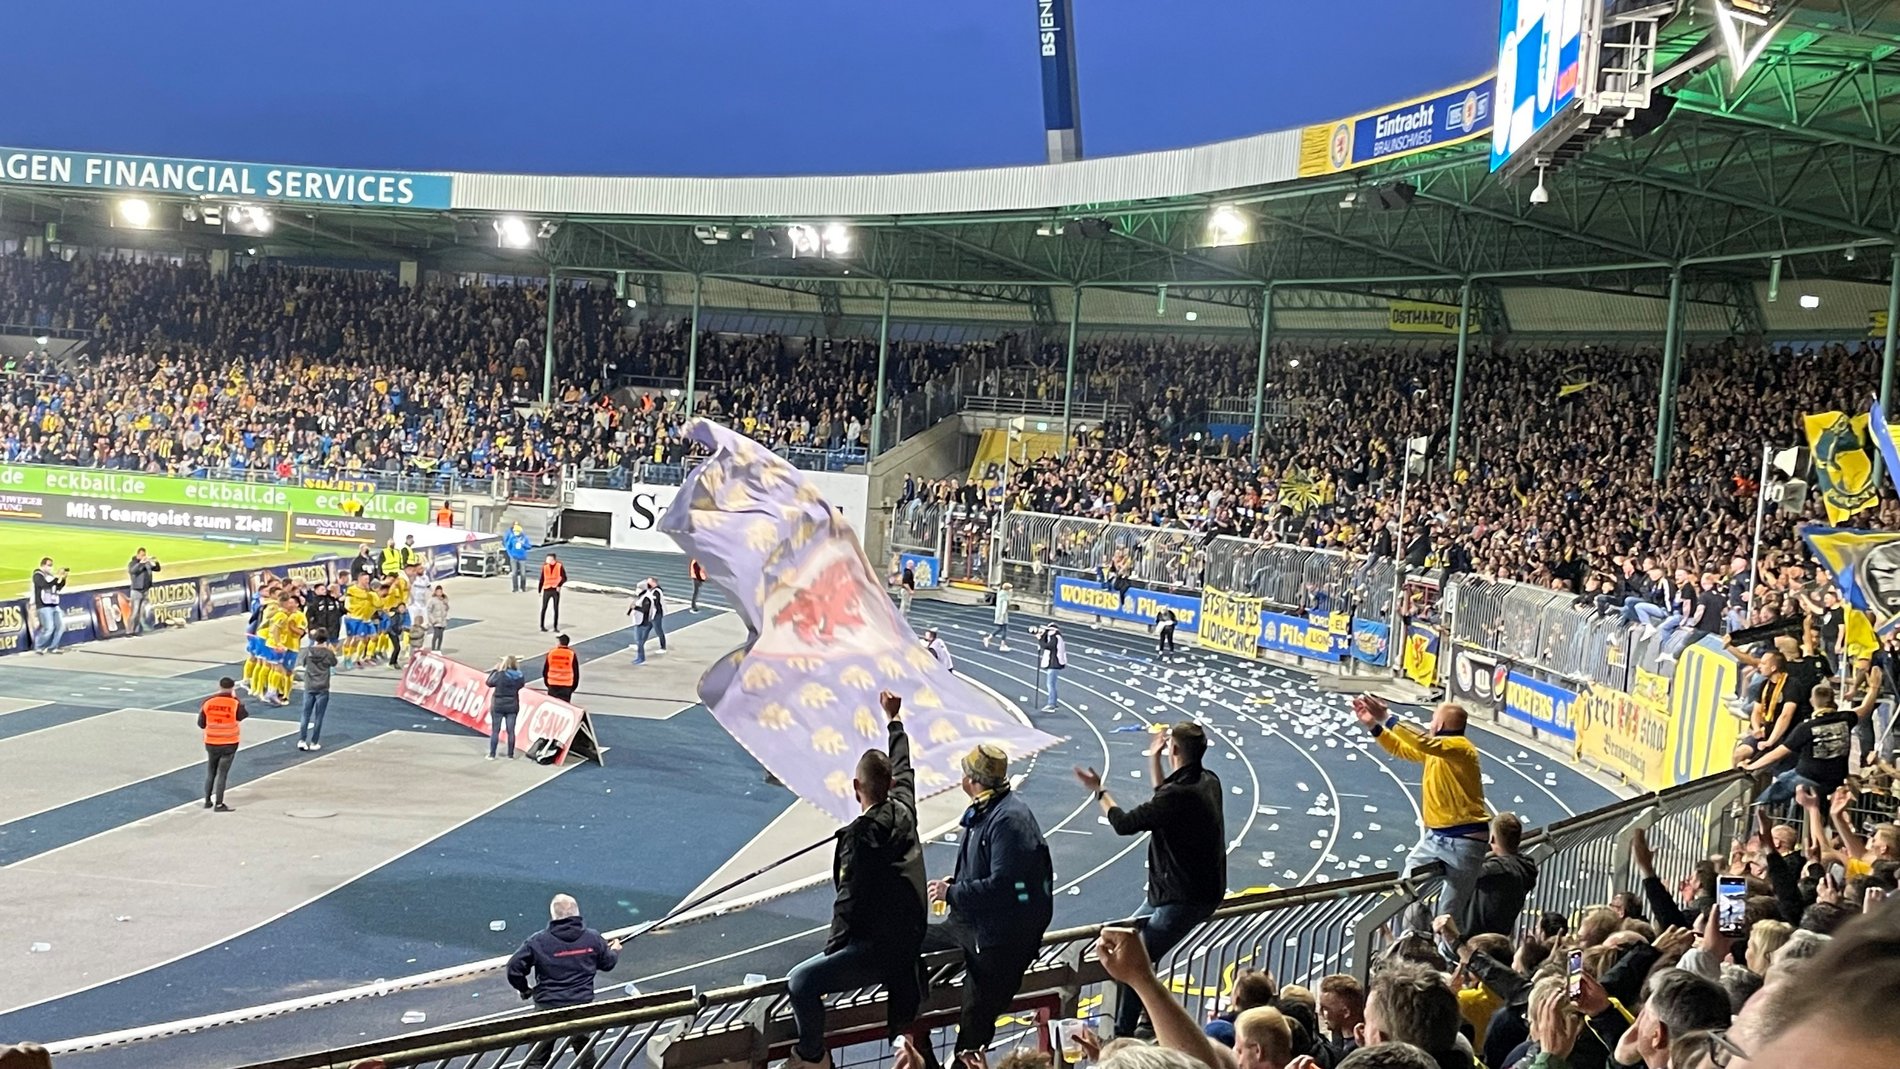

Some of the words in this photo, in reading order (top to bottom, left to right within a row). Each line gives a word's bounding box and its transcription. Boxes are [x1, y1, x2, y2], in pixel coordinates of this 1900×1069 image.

[1039, 0, 1061, 57] BS|EN
[1375, 104, 1435, 138] Eintracht
[1373, 129, 1433, 157] BRAUNSCHWEIG
[86, 158, 256, 195] FINANCIAL
[266, 169, 415, 204] SERVICES
[46, 473, 146, 493] eckball.de
[185, 482, 287, 504] eckball.de
[565, 480, 577, 492] 10
[67, 501, 96, 520] Mit
[100, 505, 190, 528] Teamgeist
[193, 514, 231, 530] zum
[234, 515, 273, 533] Ziel!
[296, 517, 376, 532] BRAUNSCHWEIGER
[316, 527, 356, 538] ZEITUNG
[149, 582, 197, 604] WOLTERS
[1060, 584, 1120, 613] WOLTERS
[1201, 620, 1257, 653] LIONSPUNCH
[438, 680, 484, 718] radio
[535, 707, 571, 738] SAW
[1506, 681, 1554, 722] WOLTERS
